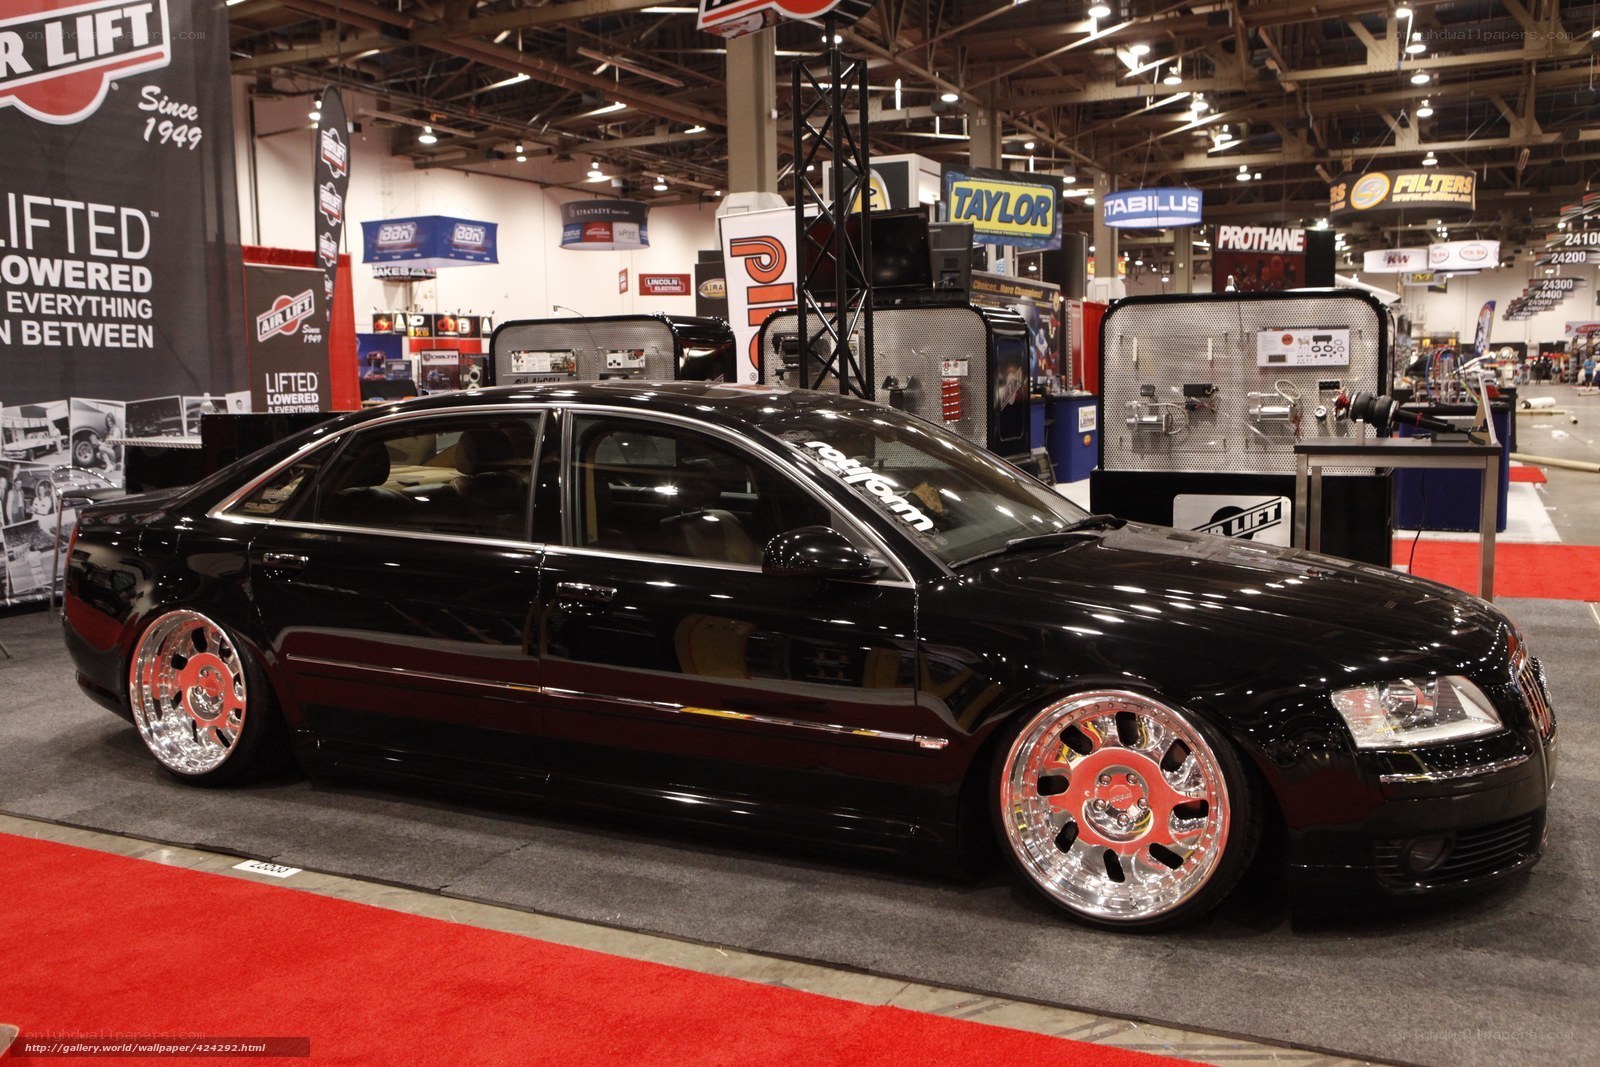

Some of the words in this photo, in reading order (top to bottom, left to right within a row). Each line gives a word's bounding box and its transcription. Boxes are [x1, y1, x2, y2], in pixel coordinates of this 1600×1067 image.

[45, 3, 152, 67] LIFT
[138, 85, 198, 121] Since
[144, 117, 202, 150] 1949
[1393, 174, 1472, 193] FILTERS
[954, 187, 1051, 227] TAYLOR
[0, 192, 150, 260] IFTED
[1218, 225, 1305, 252] PROTHANE
[1551, 251, 1586, 264] 24200
[0, 254, 153, 293] OWERED
[647, 278, 678, 286] LINCOLN
[1542, 279, 1573, 290] 24300
[7, 291, 153, 319] EVERYTHING
[1534, 290, 1562, 299] 24400
[261, 313, 284, 334] AIR
[286, 297, 312, 320] LIFT
[302, 324, 321, 334] Since
[21, 320, 154, 349] BETWEEN
[303, 335, 322, 343] 1949
[265, 372, 318, 393] LIFTED
[267, 393, 319, 405] LOWERED
[275, 404, 320, 414] EVERYTHING
[1231, 504, 1279, 535] LIFT
